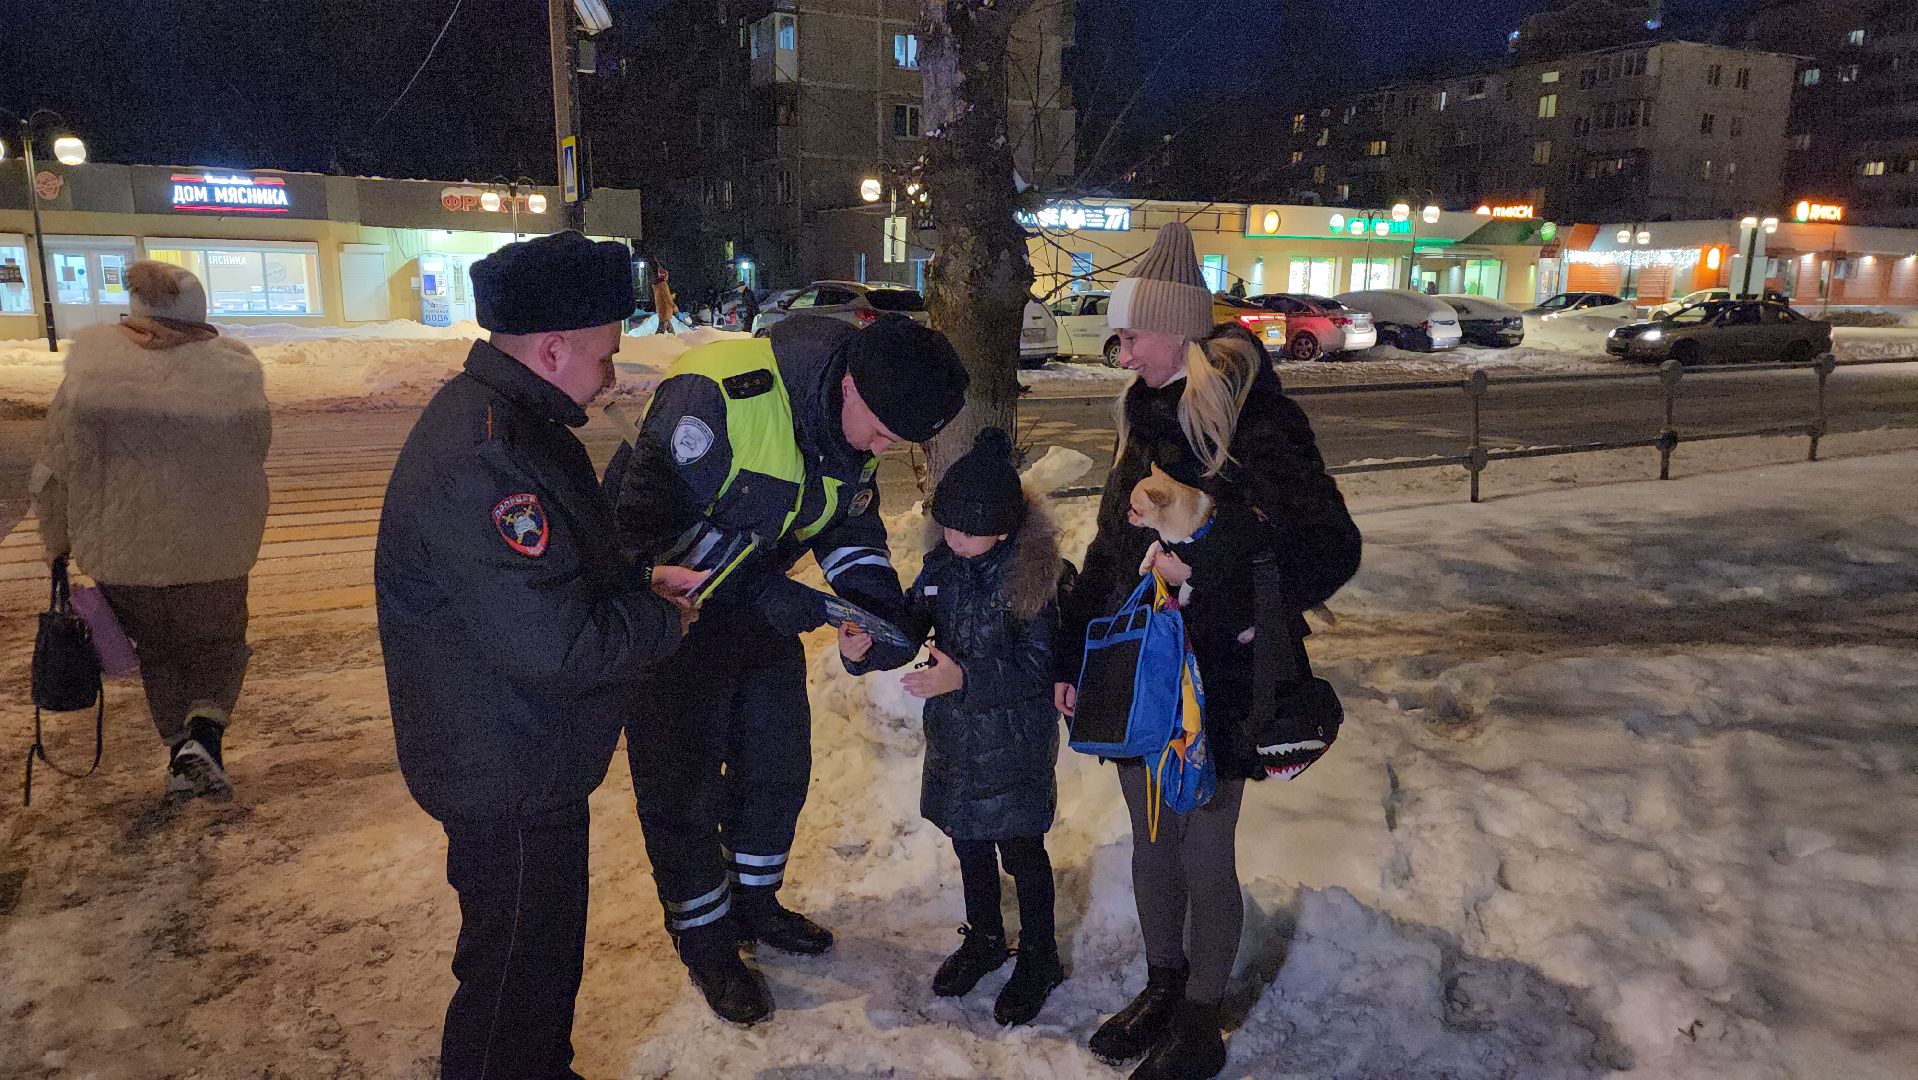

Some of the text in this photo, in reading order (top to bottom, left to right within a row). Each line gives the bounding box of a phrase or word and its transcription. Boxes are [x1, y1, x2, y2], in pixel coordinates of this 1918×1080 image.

[173, 185, 289, 206] ДОМ МЯСНИКА
[441, 194, 547, 215] ФРКТ
[425, 314, 449, 323] ВОДА
